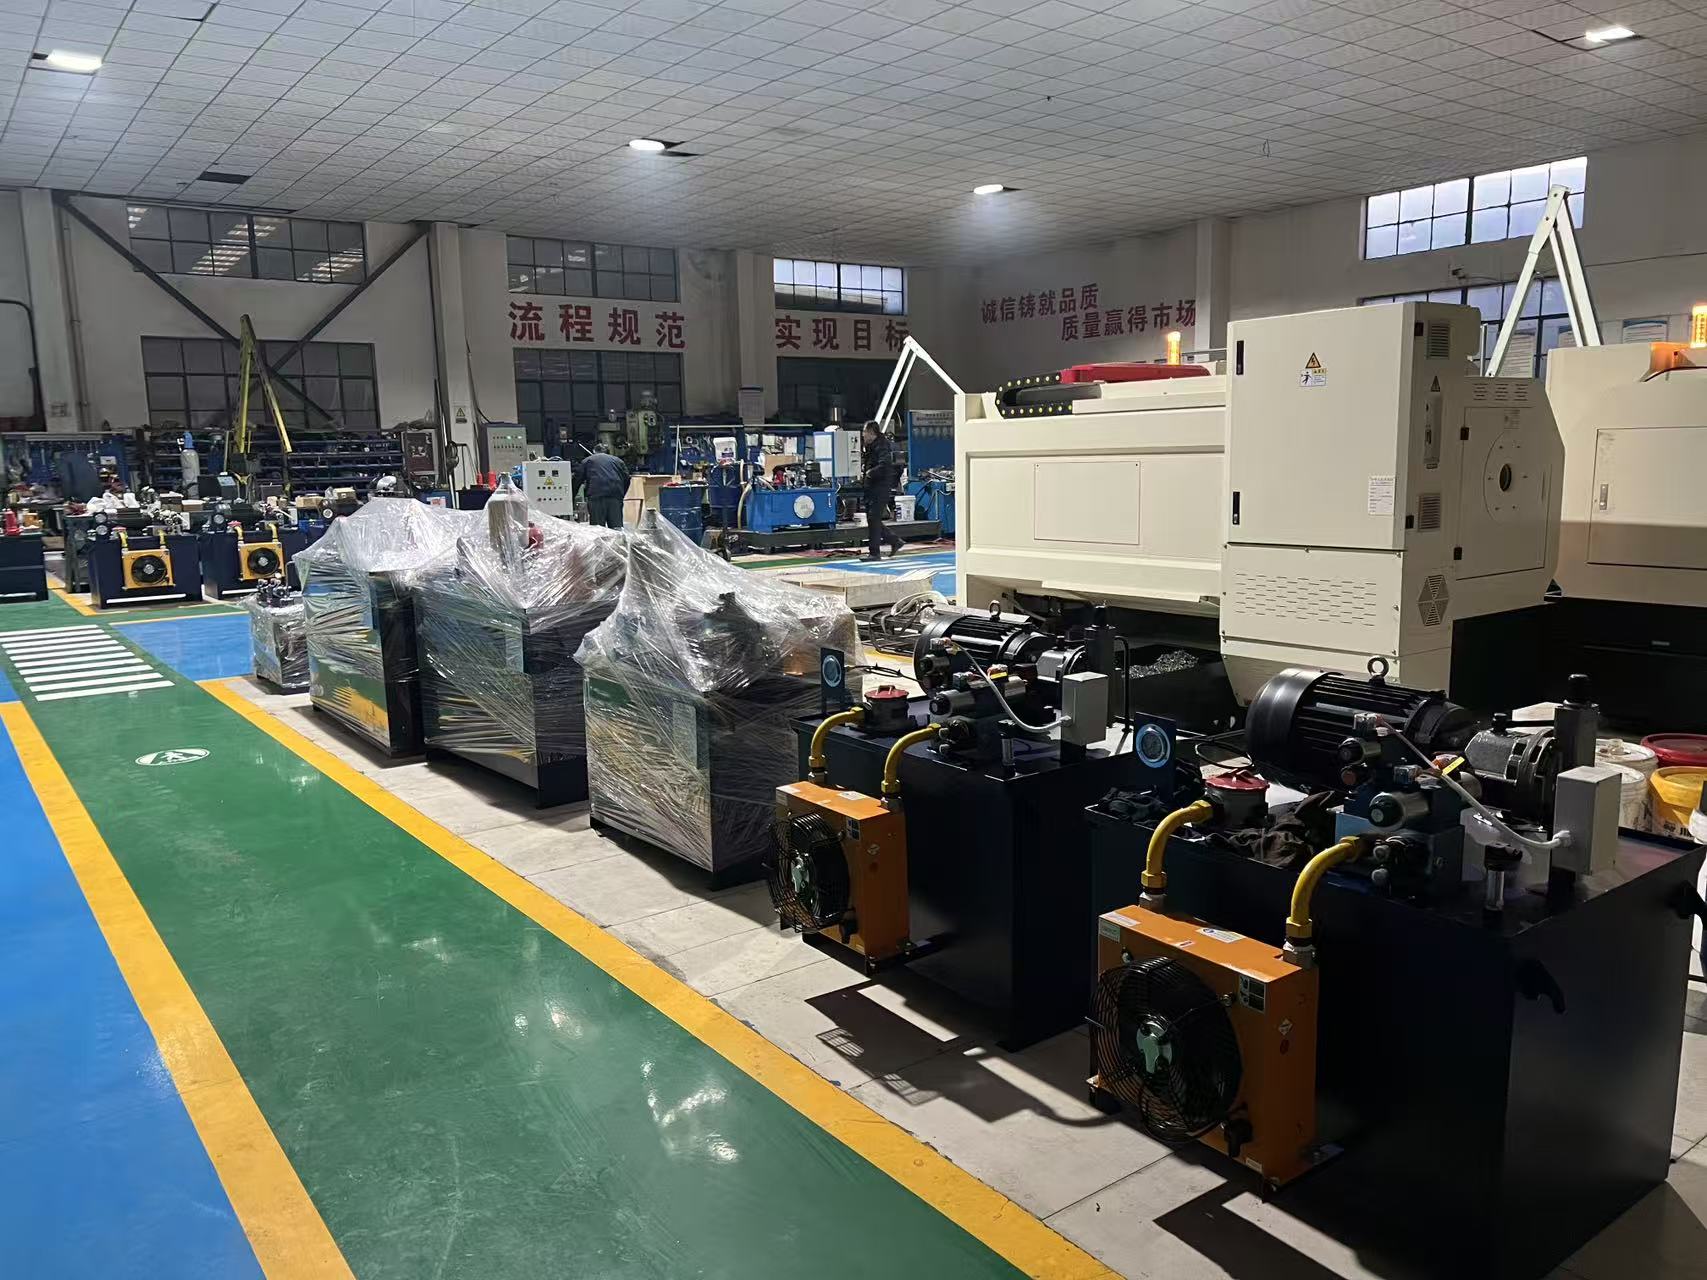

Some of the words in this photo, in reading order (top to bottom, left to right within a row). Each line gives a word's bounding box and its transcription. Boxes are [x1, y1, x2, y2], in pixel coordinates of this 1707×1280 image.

[981, 283, 1099, 324] 诚信铸就品质
[1061, 299, 1197, 341] 质量赢得市场
[508, 301, 686, 349] 流程规范
[775, 315, 909, 352] 实现目标
